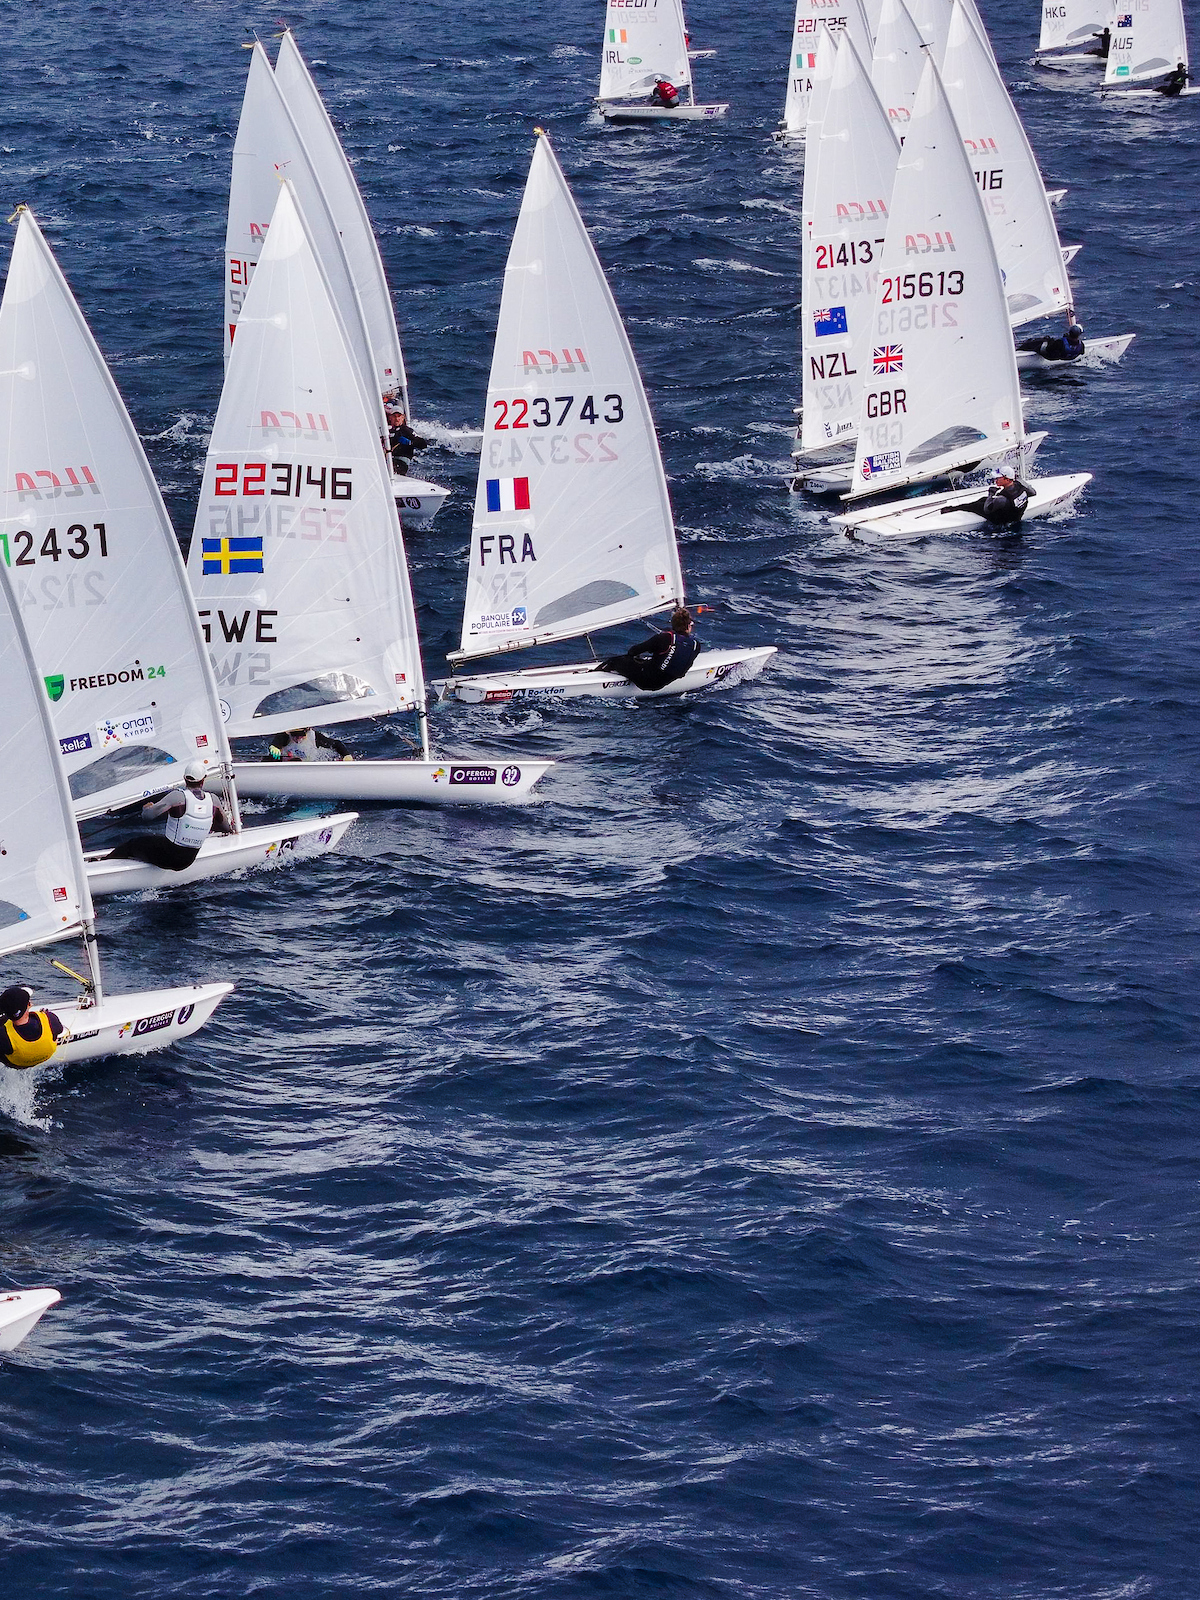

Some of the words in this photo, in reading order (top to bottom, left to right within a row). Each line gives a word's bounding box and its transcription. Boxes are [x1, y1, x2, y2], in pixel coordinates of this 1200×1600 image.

[1045, 6, 1066, 19] HKG
[1112, 38, 1133, 50] AUS
[606, 51, 624, 63] IRL
[794, 78, 813, 93] ITA
[882, 270, 965, 304] 215613
[810, 352, 857, 380] NZL
[867, 389, 907, 418] GBR
[493, 394, 624, 430] 223743
[214, 463, 352, 500] 223146
[480, 533, 537, 567] FRA
[471, 620, 511, 629] POPULAIRE
[481, 613, 510, 622] BANQUE
[70, 668, 144, 691] FREEDOM
[147, 665, 166, 679] 24
[528, 687, 565, 697] Rockfon
[504, 769, 517, 784] 32
[149, 1011, 173, 1025] FERGUS
